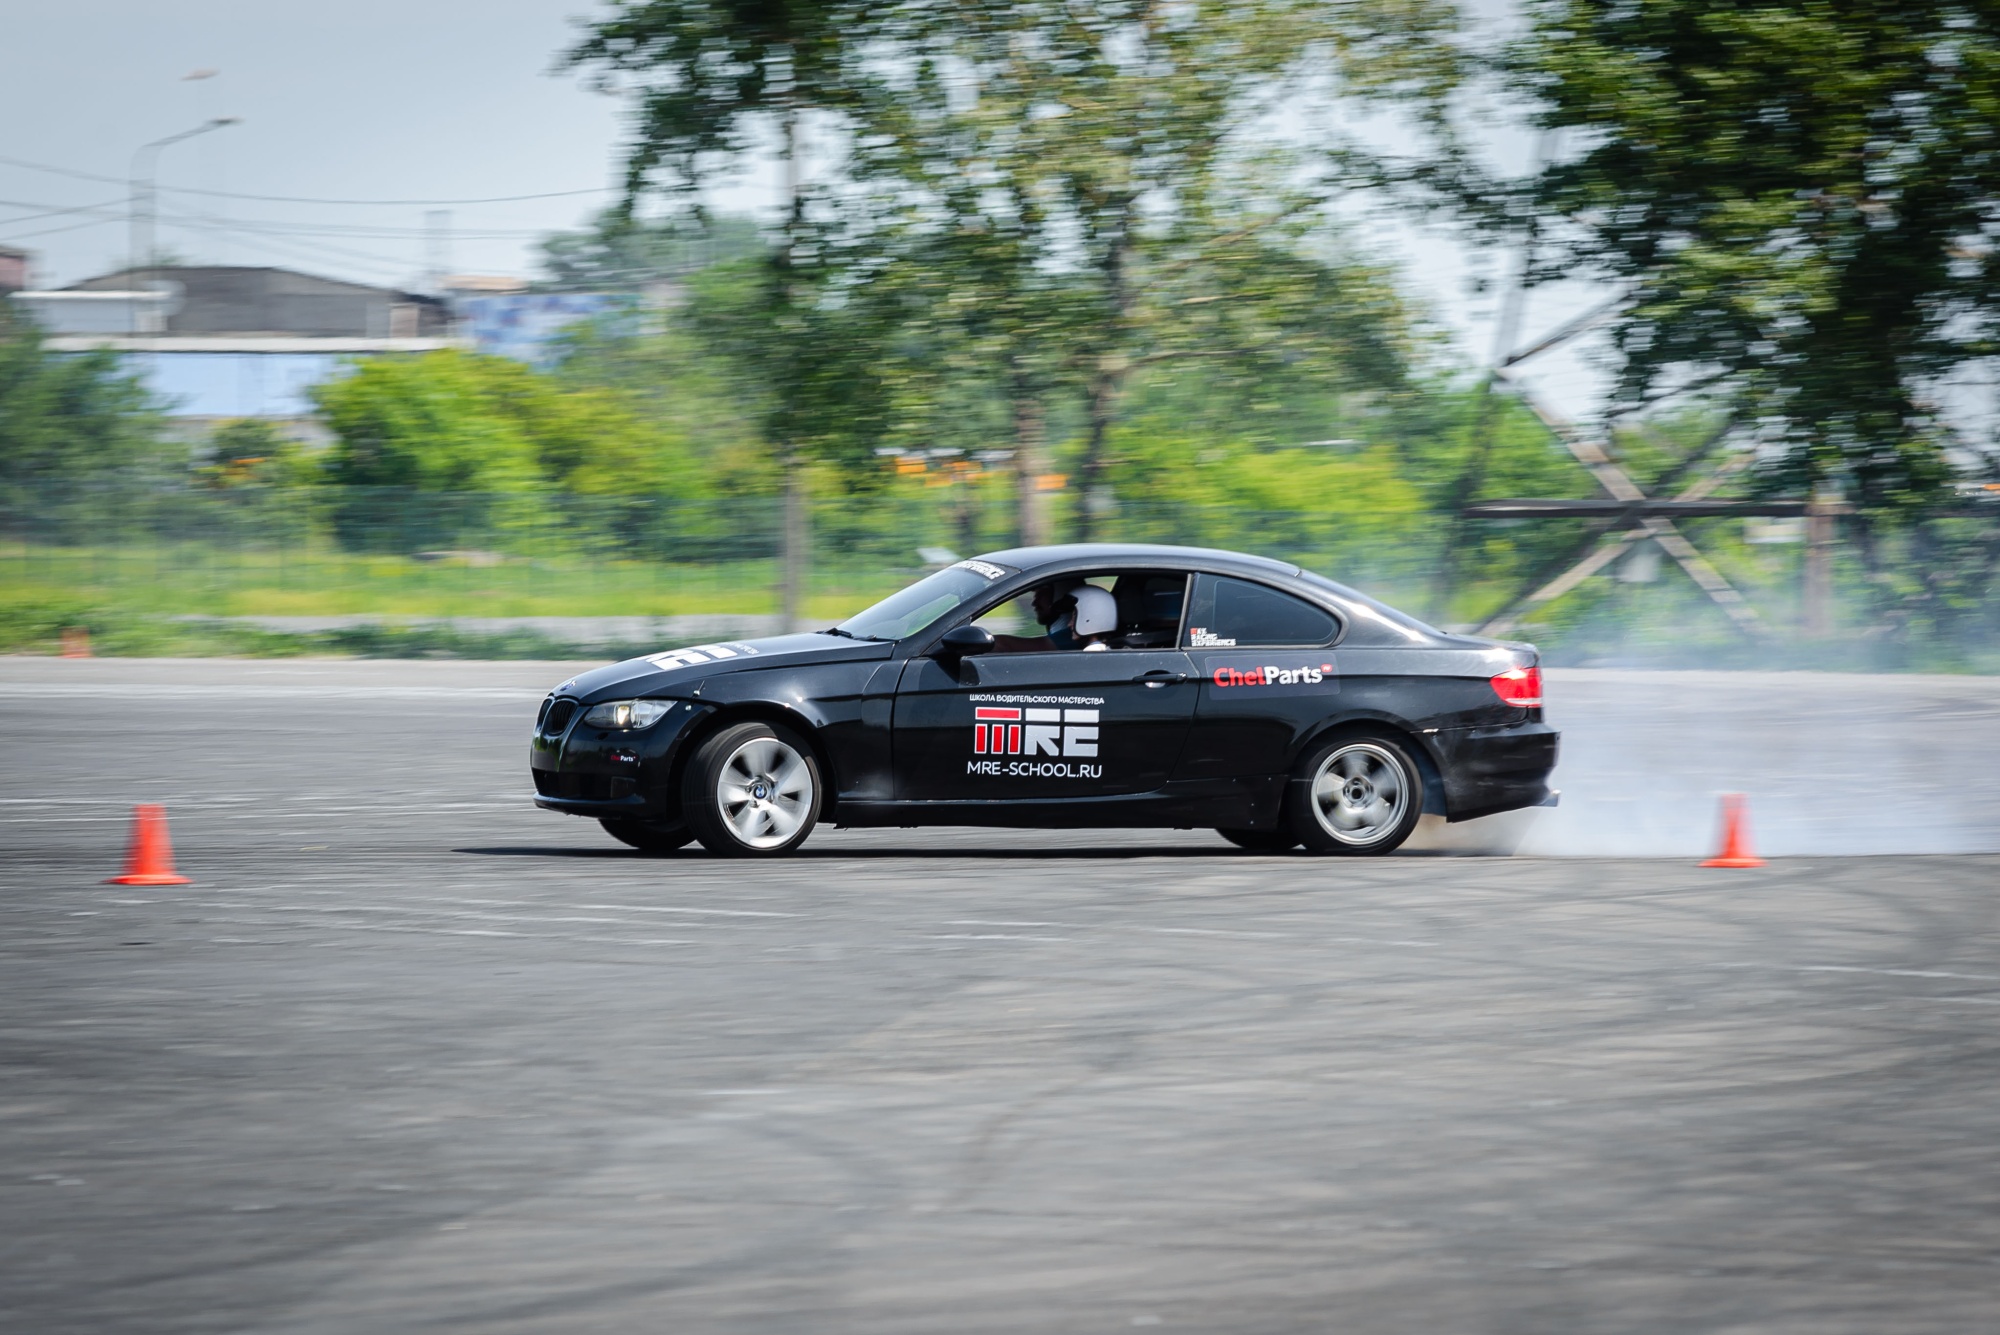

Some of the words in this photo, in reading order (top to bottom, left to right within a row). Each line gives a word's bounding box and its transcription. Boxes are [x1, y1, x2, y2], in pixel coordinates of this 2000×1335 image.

[1213, 666, 1323, 687] ChelParts
[969, 694, 996, 702] ШКОЛА
[996, 694, 1058, 704] ВОДИТЕЛЬСКОГО
[1058, 696, 1105, 705] МАСТЕРСТВА
[967, 760, 1102, 778] MRE-SCHOOL.RU
